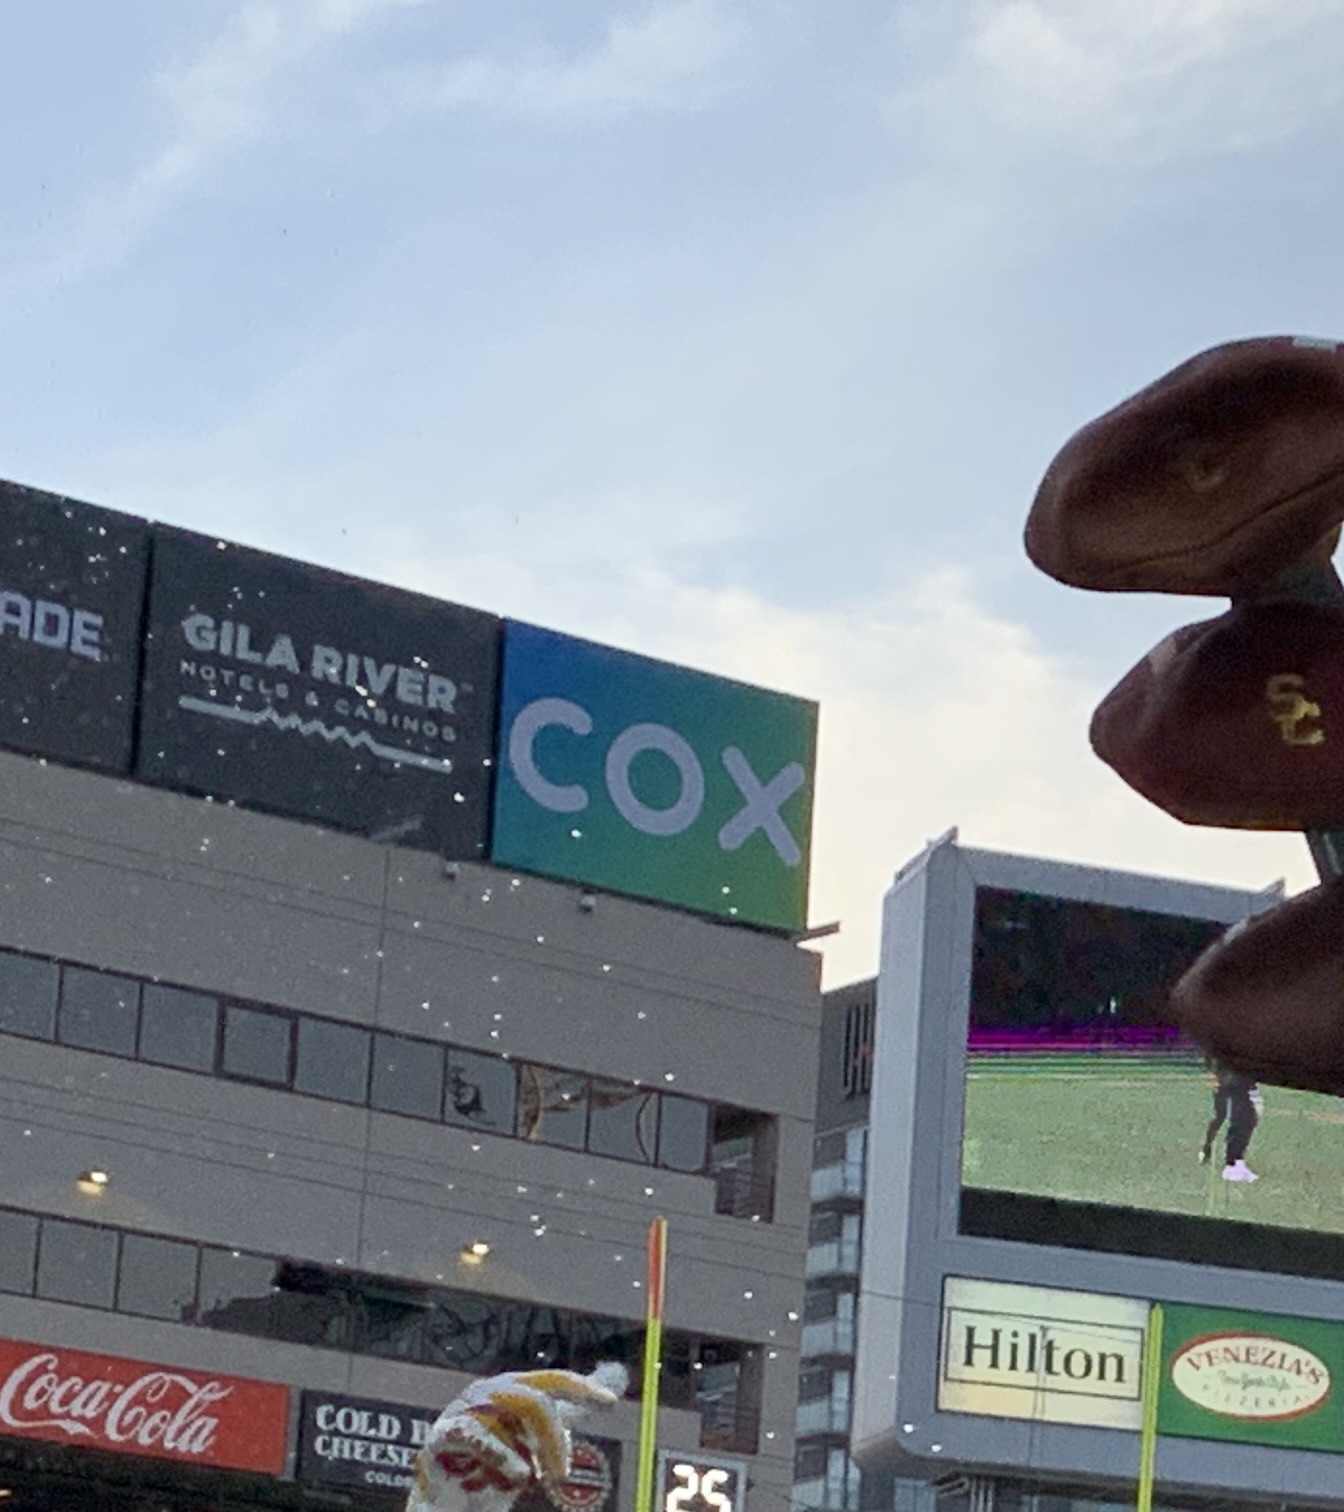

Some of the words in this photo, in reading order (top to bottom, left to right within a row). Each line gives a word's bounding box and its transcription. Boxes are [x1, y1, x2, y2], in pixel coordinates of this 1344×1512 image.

[0, 591, 103, 660] ADE
[183, 614, 300, 675] GILA
[311, 645, 458, 714] RIVER
[180, 659, 290, 698] HOTELS
[334, 699, 457, 743] CASINOS
[508, 697, 806, 867] COX
[963, 1325, 1127, 1384] Hilton
[1187, 1346, 1325, 1385] VENEZIA'S
[0, 1353, 234, 1454] Coca-Cola
[316, 1404, 401, 1440] COLD
[314, 1434, 416, 1468] CHEESE
